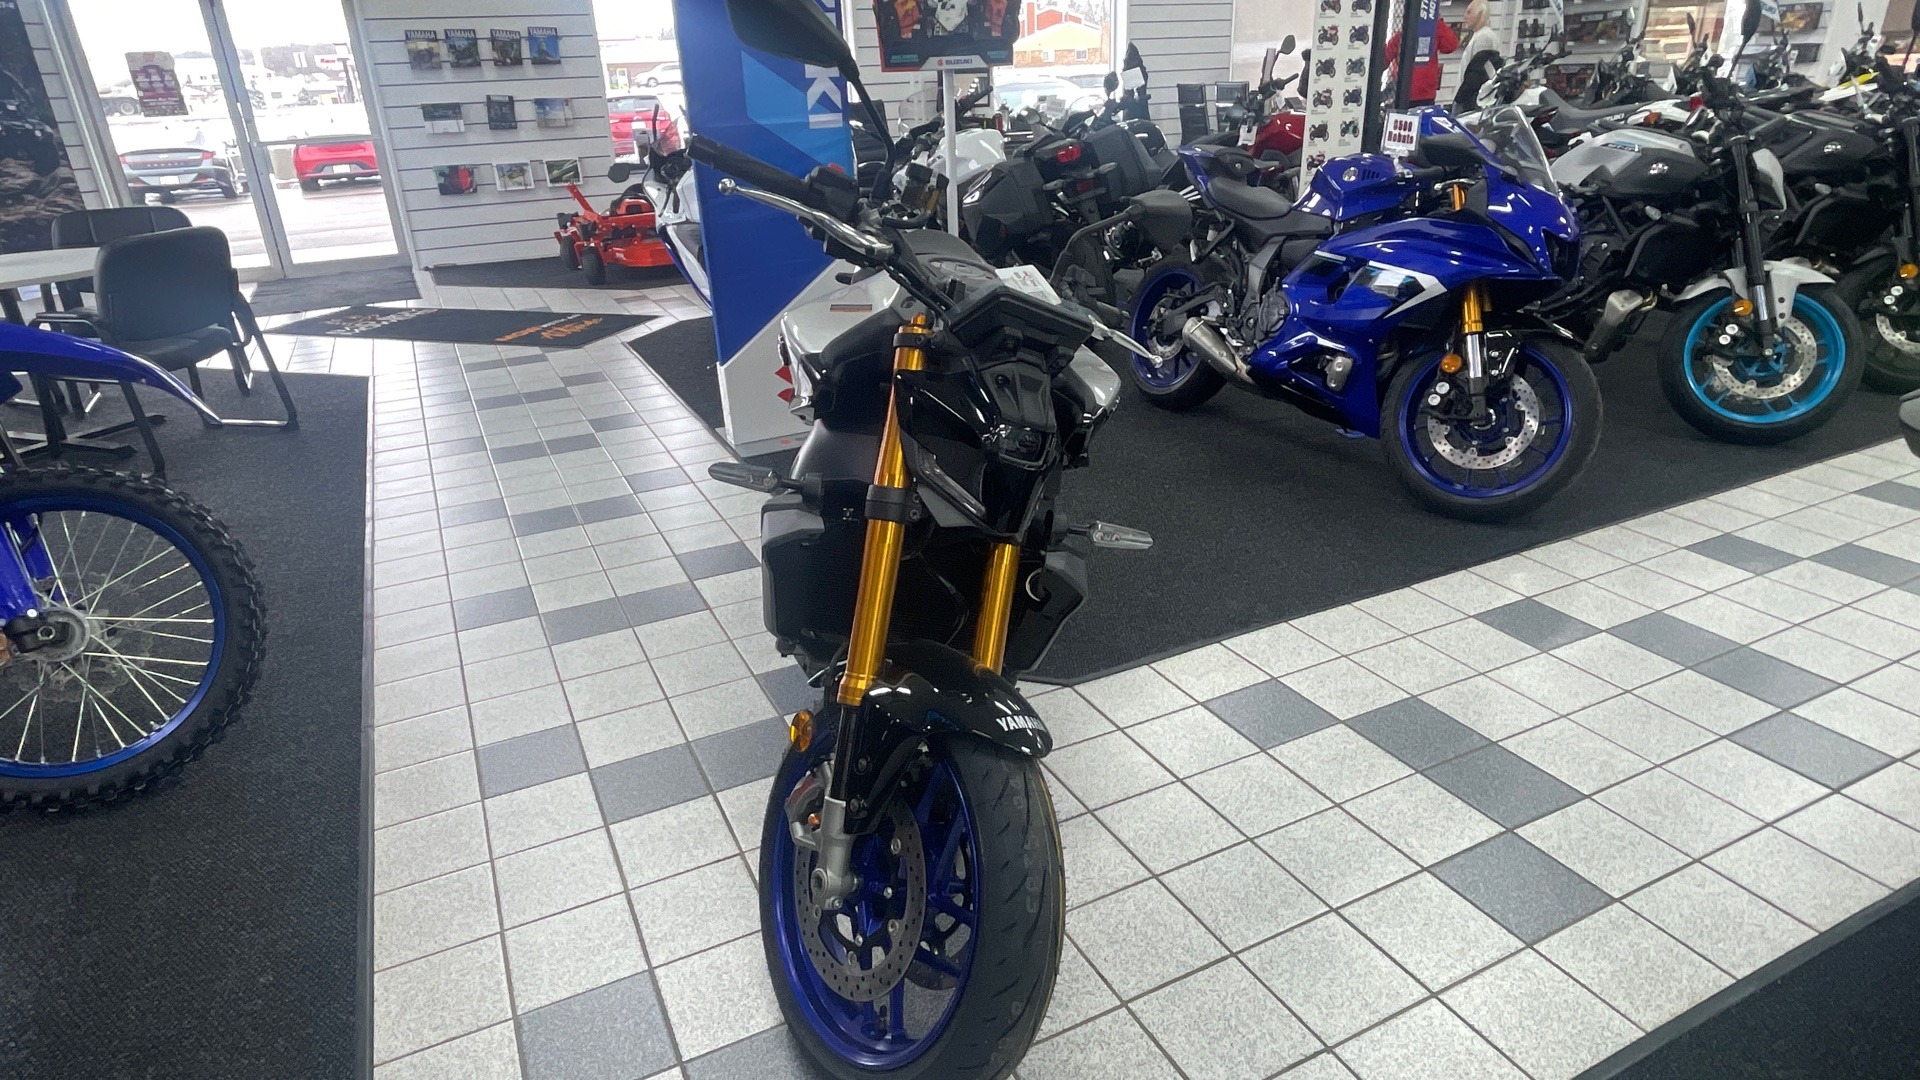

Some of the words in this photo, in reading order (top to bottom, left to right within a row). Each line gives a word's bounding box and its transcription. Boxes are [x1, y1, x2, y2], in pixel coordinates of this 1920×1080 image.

[407, 30, 436, 39] YAMAHA
[447, 30, 475, 38] YAMAHA
[491, 30, 520, 39] YAMAHA
[529, 27, 556, 36] YAMAHA
